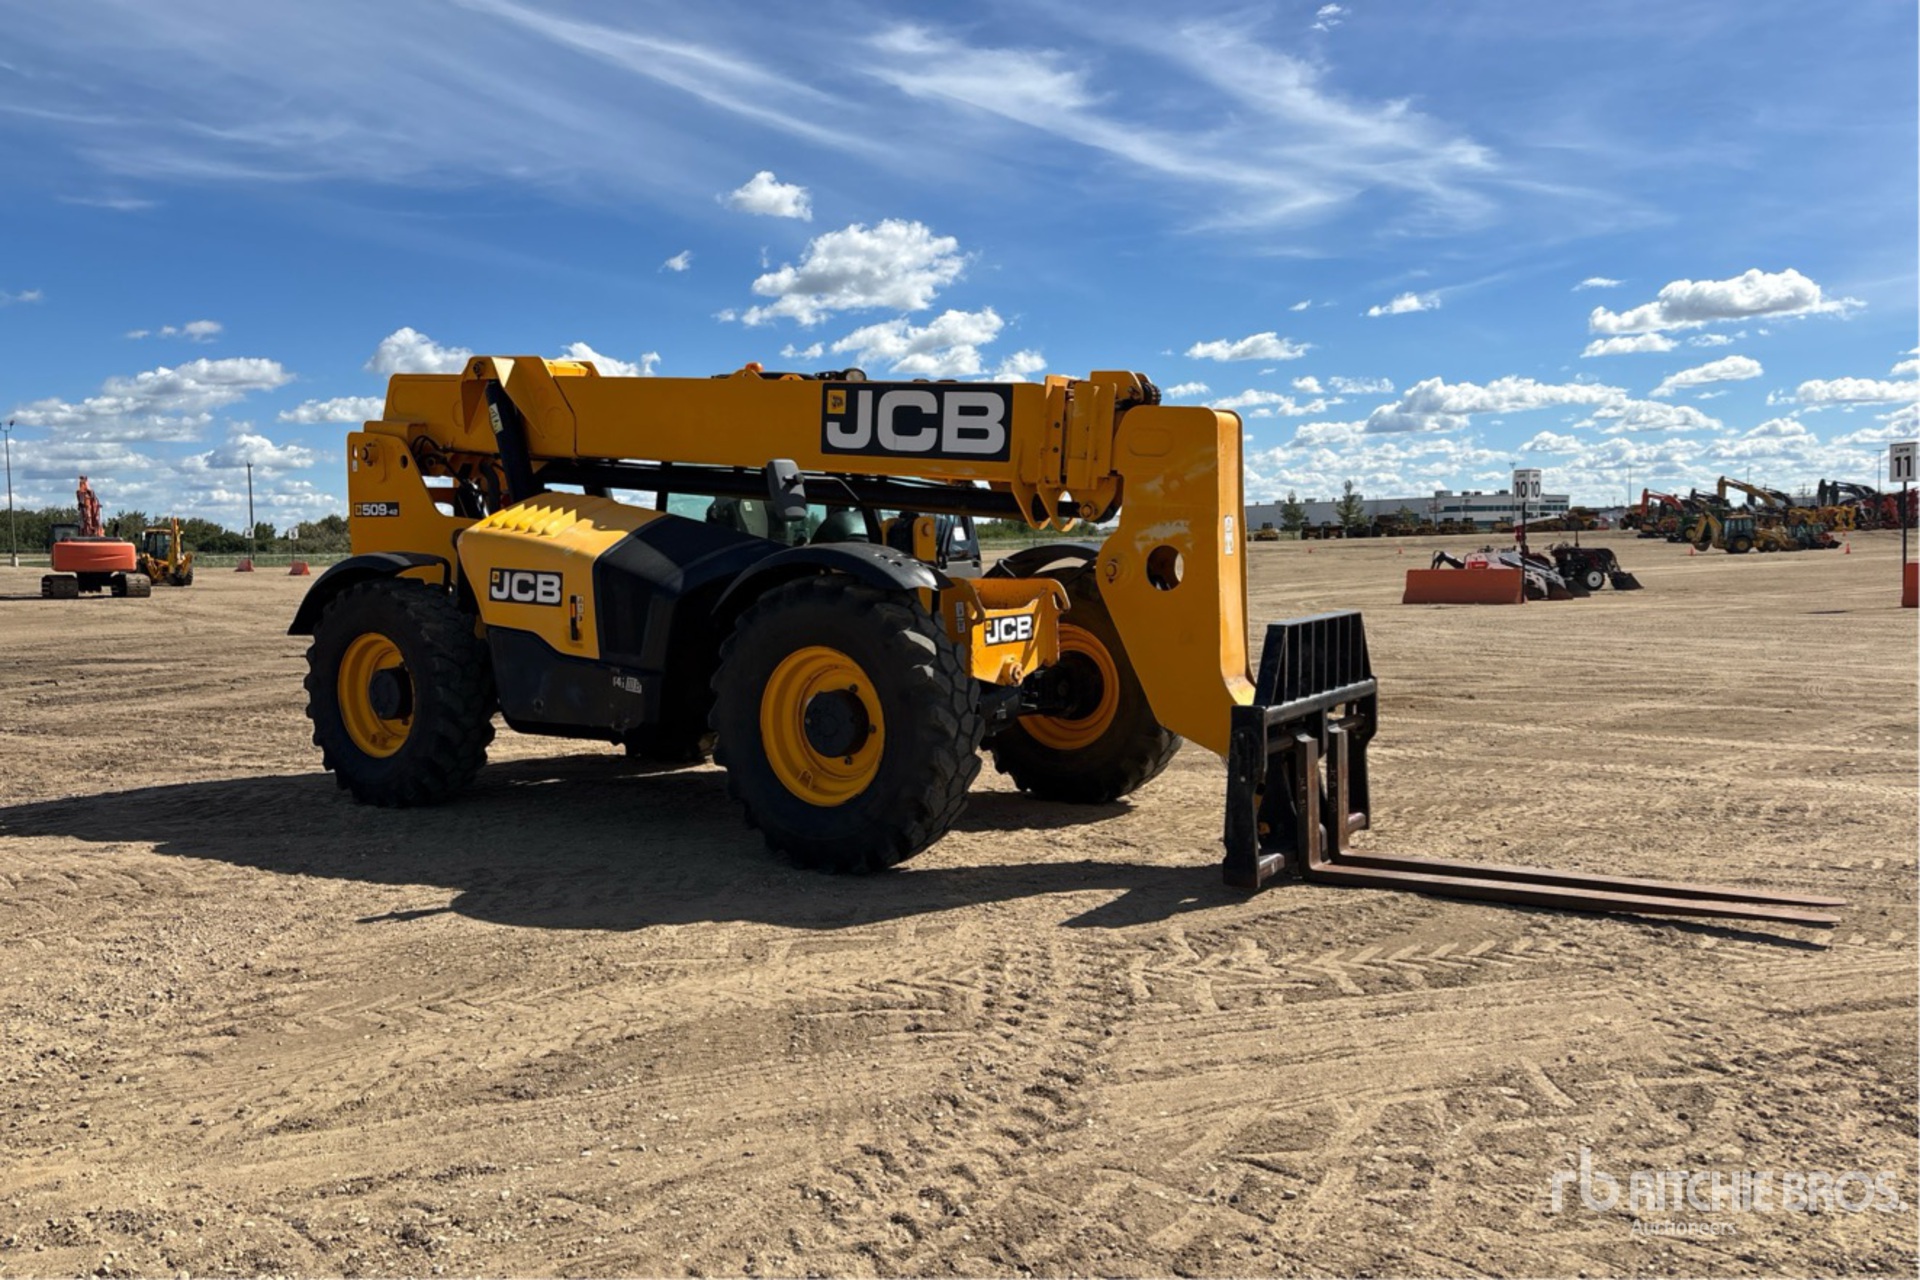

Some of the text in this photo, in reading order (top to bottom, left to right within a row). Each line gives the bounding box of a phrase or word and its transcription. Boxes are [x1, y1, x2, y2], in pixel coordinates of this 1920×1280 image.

[826, 389, 1005, 454] JCB
[1894, 455, 1911, 477] 11
[1515, 481, 1528, 498] 10
[1530, 481, 1540, 498] 10
[491, 571, 561, 603] JCB
[986, 615, 1032, 644] JCB
